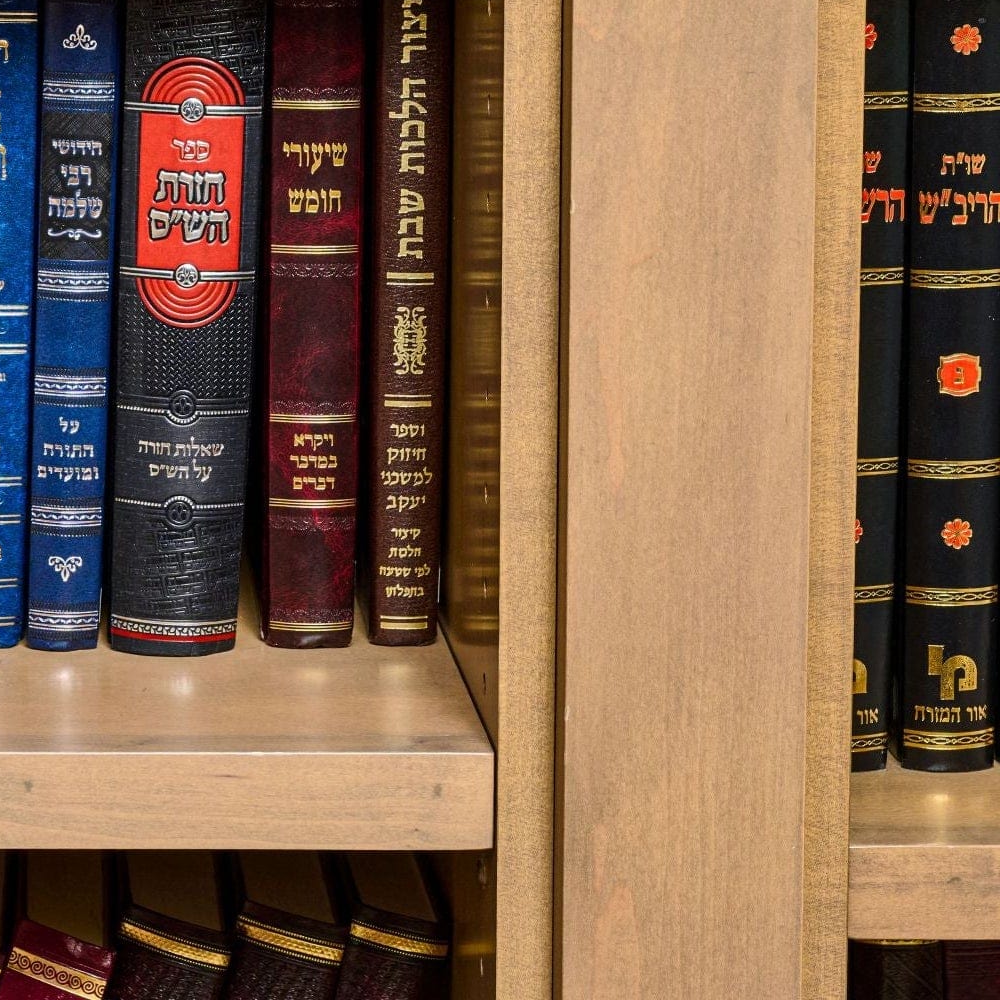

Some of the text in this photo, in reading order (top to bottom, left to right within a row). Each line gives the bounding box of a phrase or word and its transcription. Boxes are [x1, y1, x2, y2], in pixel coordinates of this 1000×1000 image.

[388, 77, 428, 174] הלכות
[52, 139, 103, 156] חידושי
[170, 137, 212, 163] ספר
[283, 142, 348, 175] שיעורי
[940, 151, 986, 176] שו"ת
[60, 164, 92, 186] רבי
[48, 189, 103, 219] שלמה
[288, 187, 342, 214] חומש
[148, 207, 231, 244] הש"ס
[396, 188, 426, 260] שבת
[59, 416, 80, 434] על
[390, 422, 425, 438] וספר
[43, 442, 95, 458] התורה
[174, 436, 225, 457] שאלות
[293, 433, 334, 451] ויקרא
[290, 454, 338, 469] במדבר
[386, 447, 427, 465] חיזוק
[37, 464, 99, 482] ומועדים
[192, 459, 213, 482] על
[380, 466, 433, 487] למשכני
[292, 476, 336, 491] דברים
[385, 495, 426, 513] יעקב
[391, 526, 421, 540] קיצור
[856, 708, 879, 725] אור
[914, 703, 988, 723] אור המזרח
